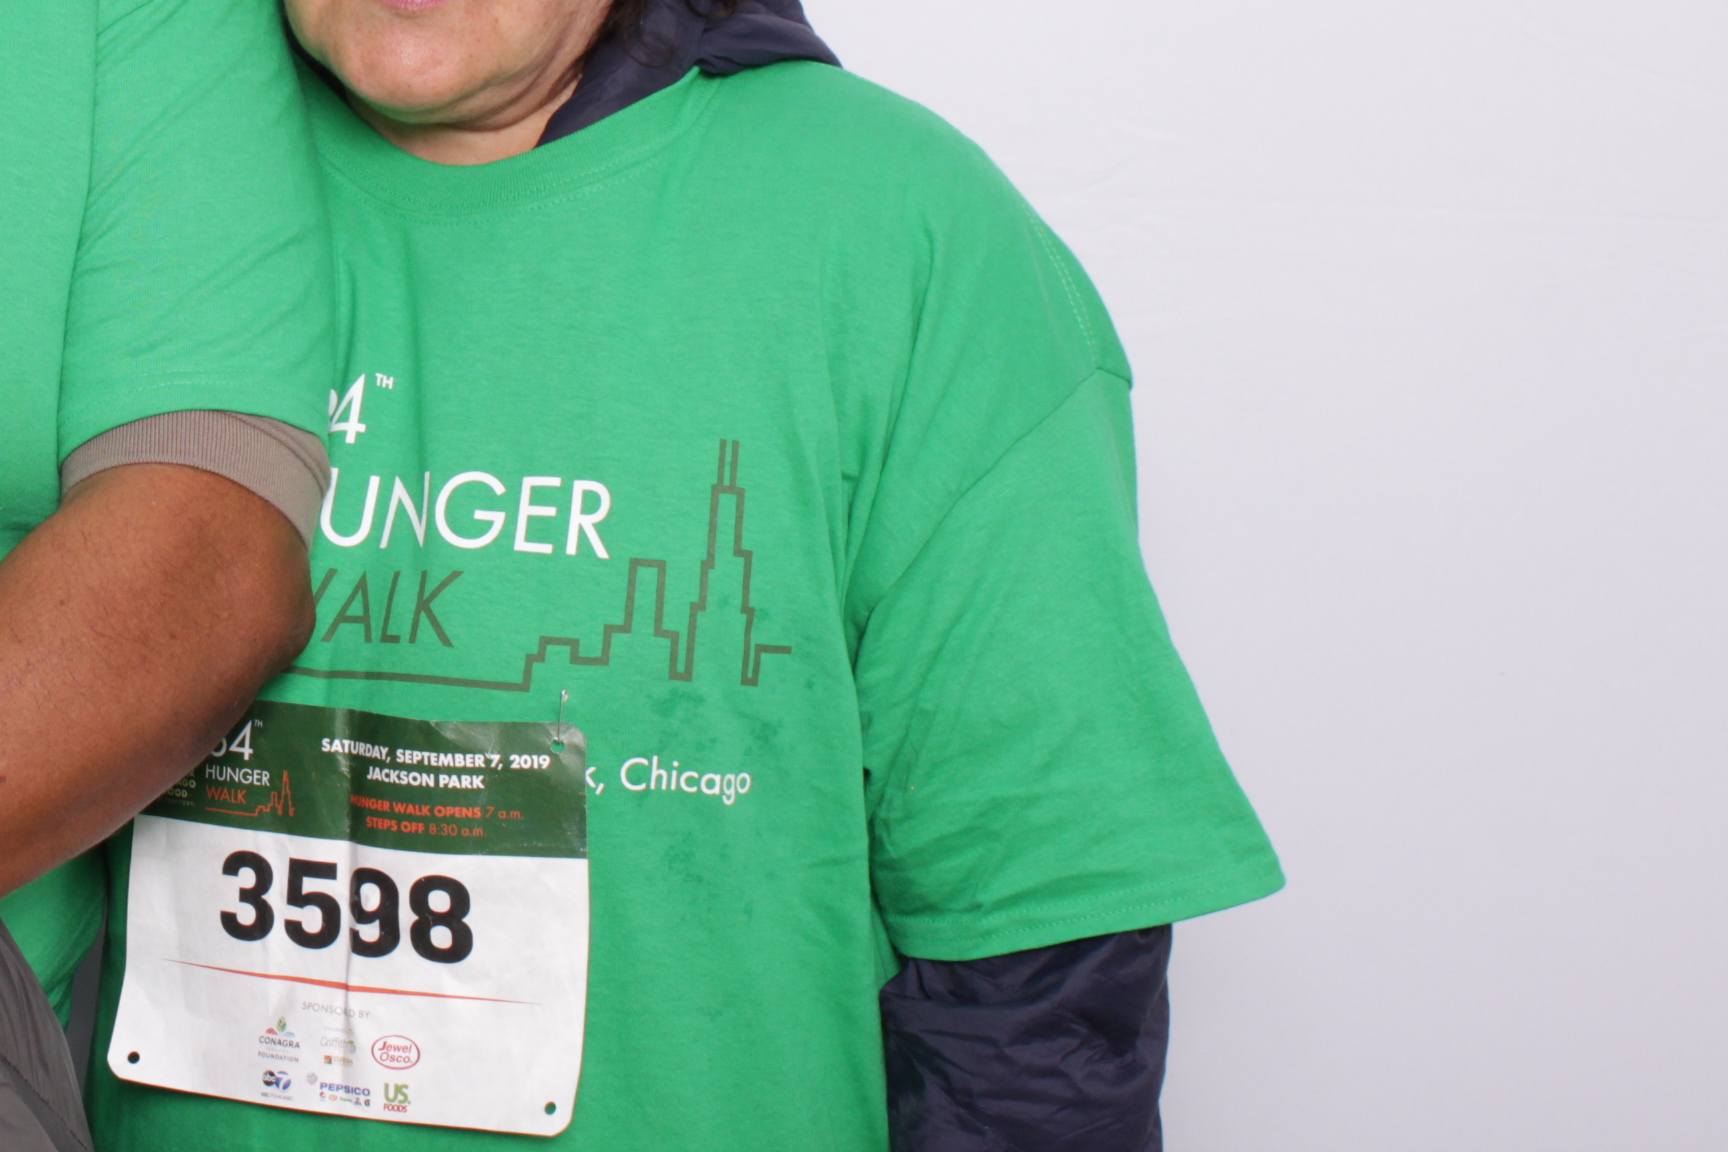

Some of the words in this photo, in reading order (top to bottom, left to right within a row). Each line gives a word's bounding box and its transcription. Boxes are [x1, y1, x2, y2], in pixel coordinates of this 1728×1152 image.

[320, 467, 611, 560] UNGER
[313, 567, 465, 648] ALK
[321, 738, 391, 763] SATURDAY,
[395, 748, 486, 768] SEPTEMBER
[489, 753, 504, 770] 7,
[509, 754, 551, 770] 2019
[205, 764, 270, 786] HUNGER
[366, 766, 435, 788] JACKSON
[439, 773, 485, 789] PARK
[620, 755, 752, 805] Chicago
[205, 785, 248, 804] WALK
[350, 793, 391, 812] HUNGER
[392, 802, 431, 817] WALK
[434, 805, 482, 819] OPENS
[485, 806, 495, 818] 7
[498, 809, 524, 820] a.m.
[366, 816, 398, 832] STEPS
[400, 820, 425, 834] OFF
[428, 823, 458, 837] 8:30
[461, 827, 487, 837] a.m.
[220, 850, 474, 964] 3598
[258, 1035, 300, 1049] CONAGRA
[378, 1041, 412, 1054] Jewel
[257, 1051, 300, 1063] FOUNDATION
[320, 1082, 371, 1097] PEPSICO
[383, 1103, 408, 1113] FOODS
